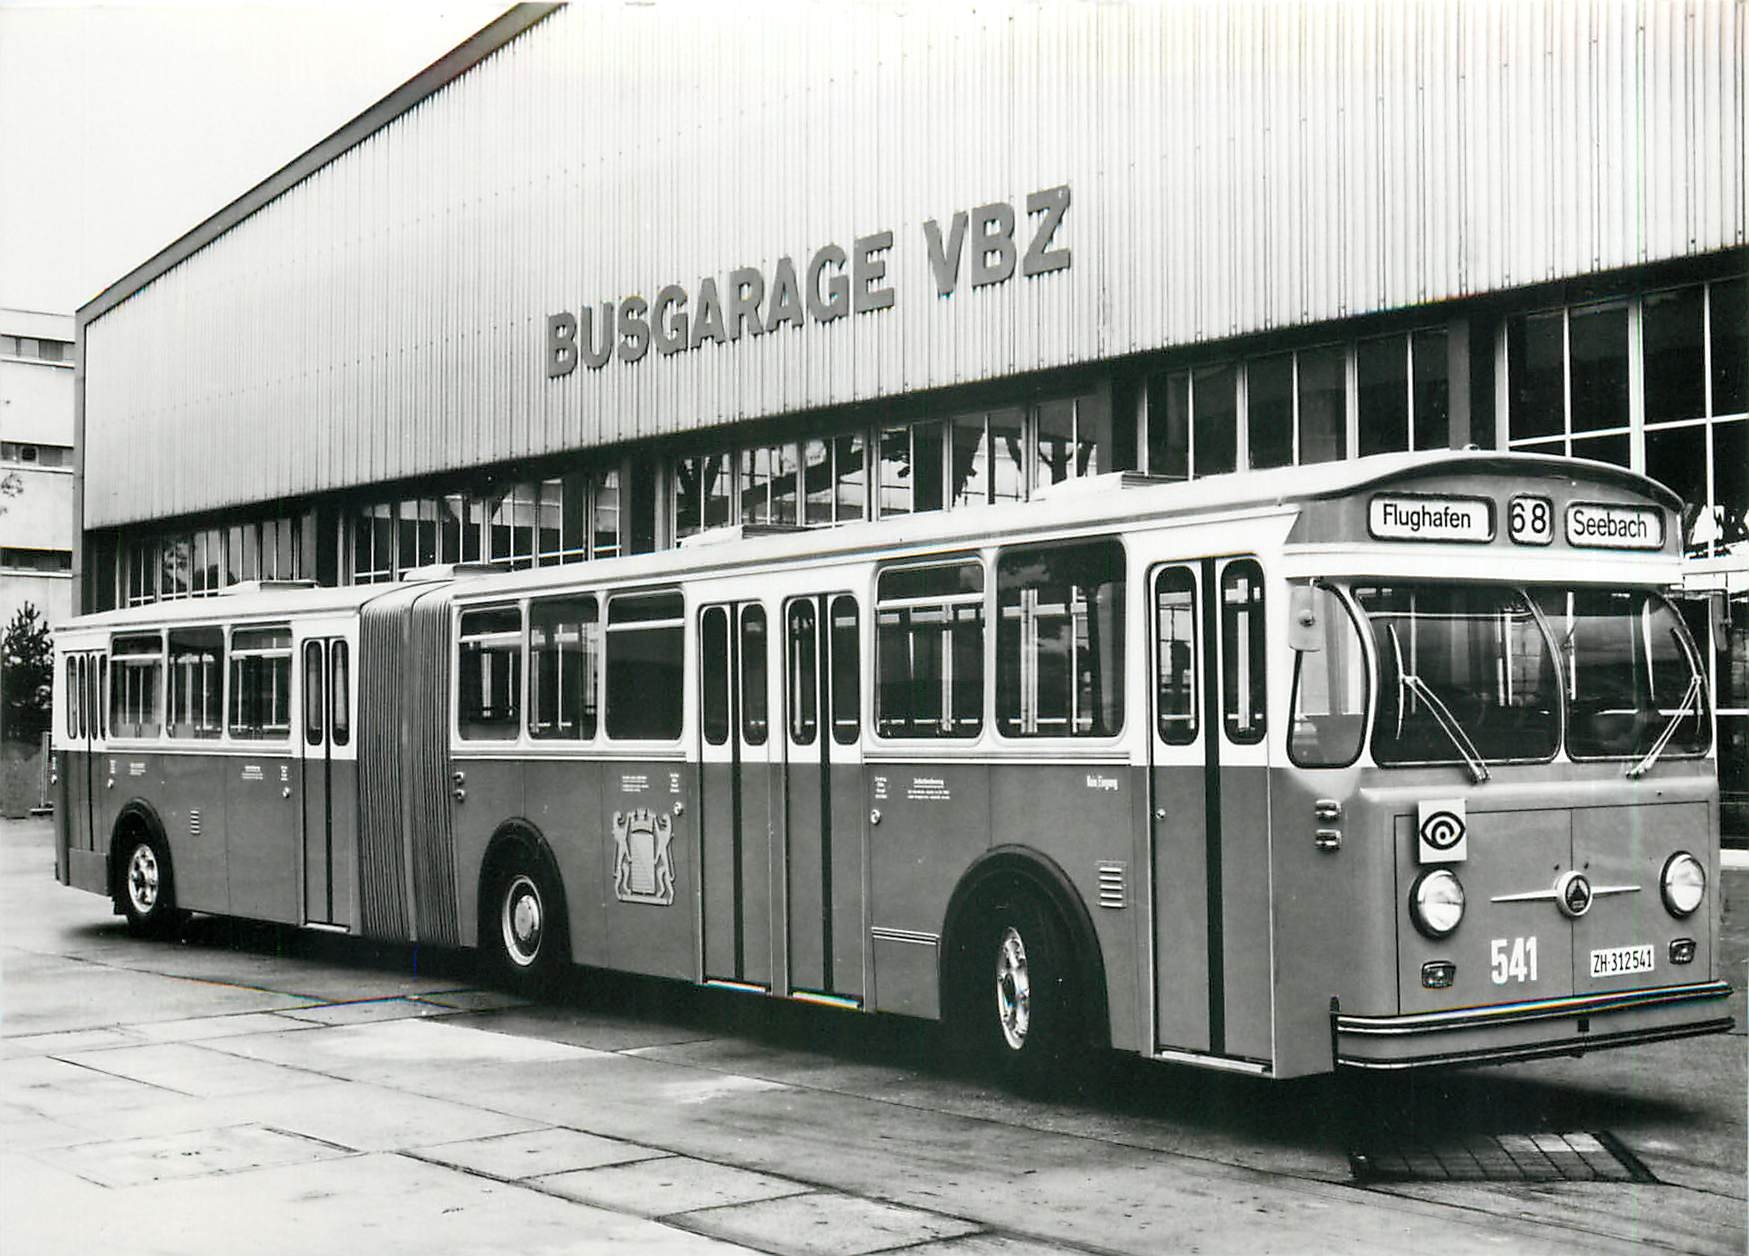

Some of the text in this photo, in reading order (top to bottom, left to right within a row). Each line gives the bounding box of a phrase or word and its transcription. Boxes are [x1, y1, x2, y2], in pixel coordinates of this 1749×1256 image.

[547, 184, 1072, 379] BUSGARAGE VBZ
[1382, 503, 1471, 531] Flughafen
[1511, 503, 1546, 533] 68
[1573, 509, 1647, 538] Seebach
[1491, 936, 1538, 984] 541
